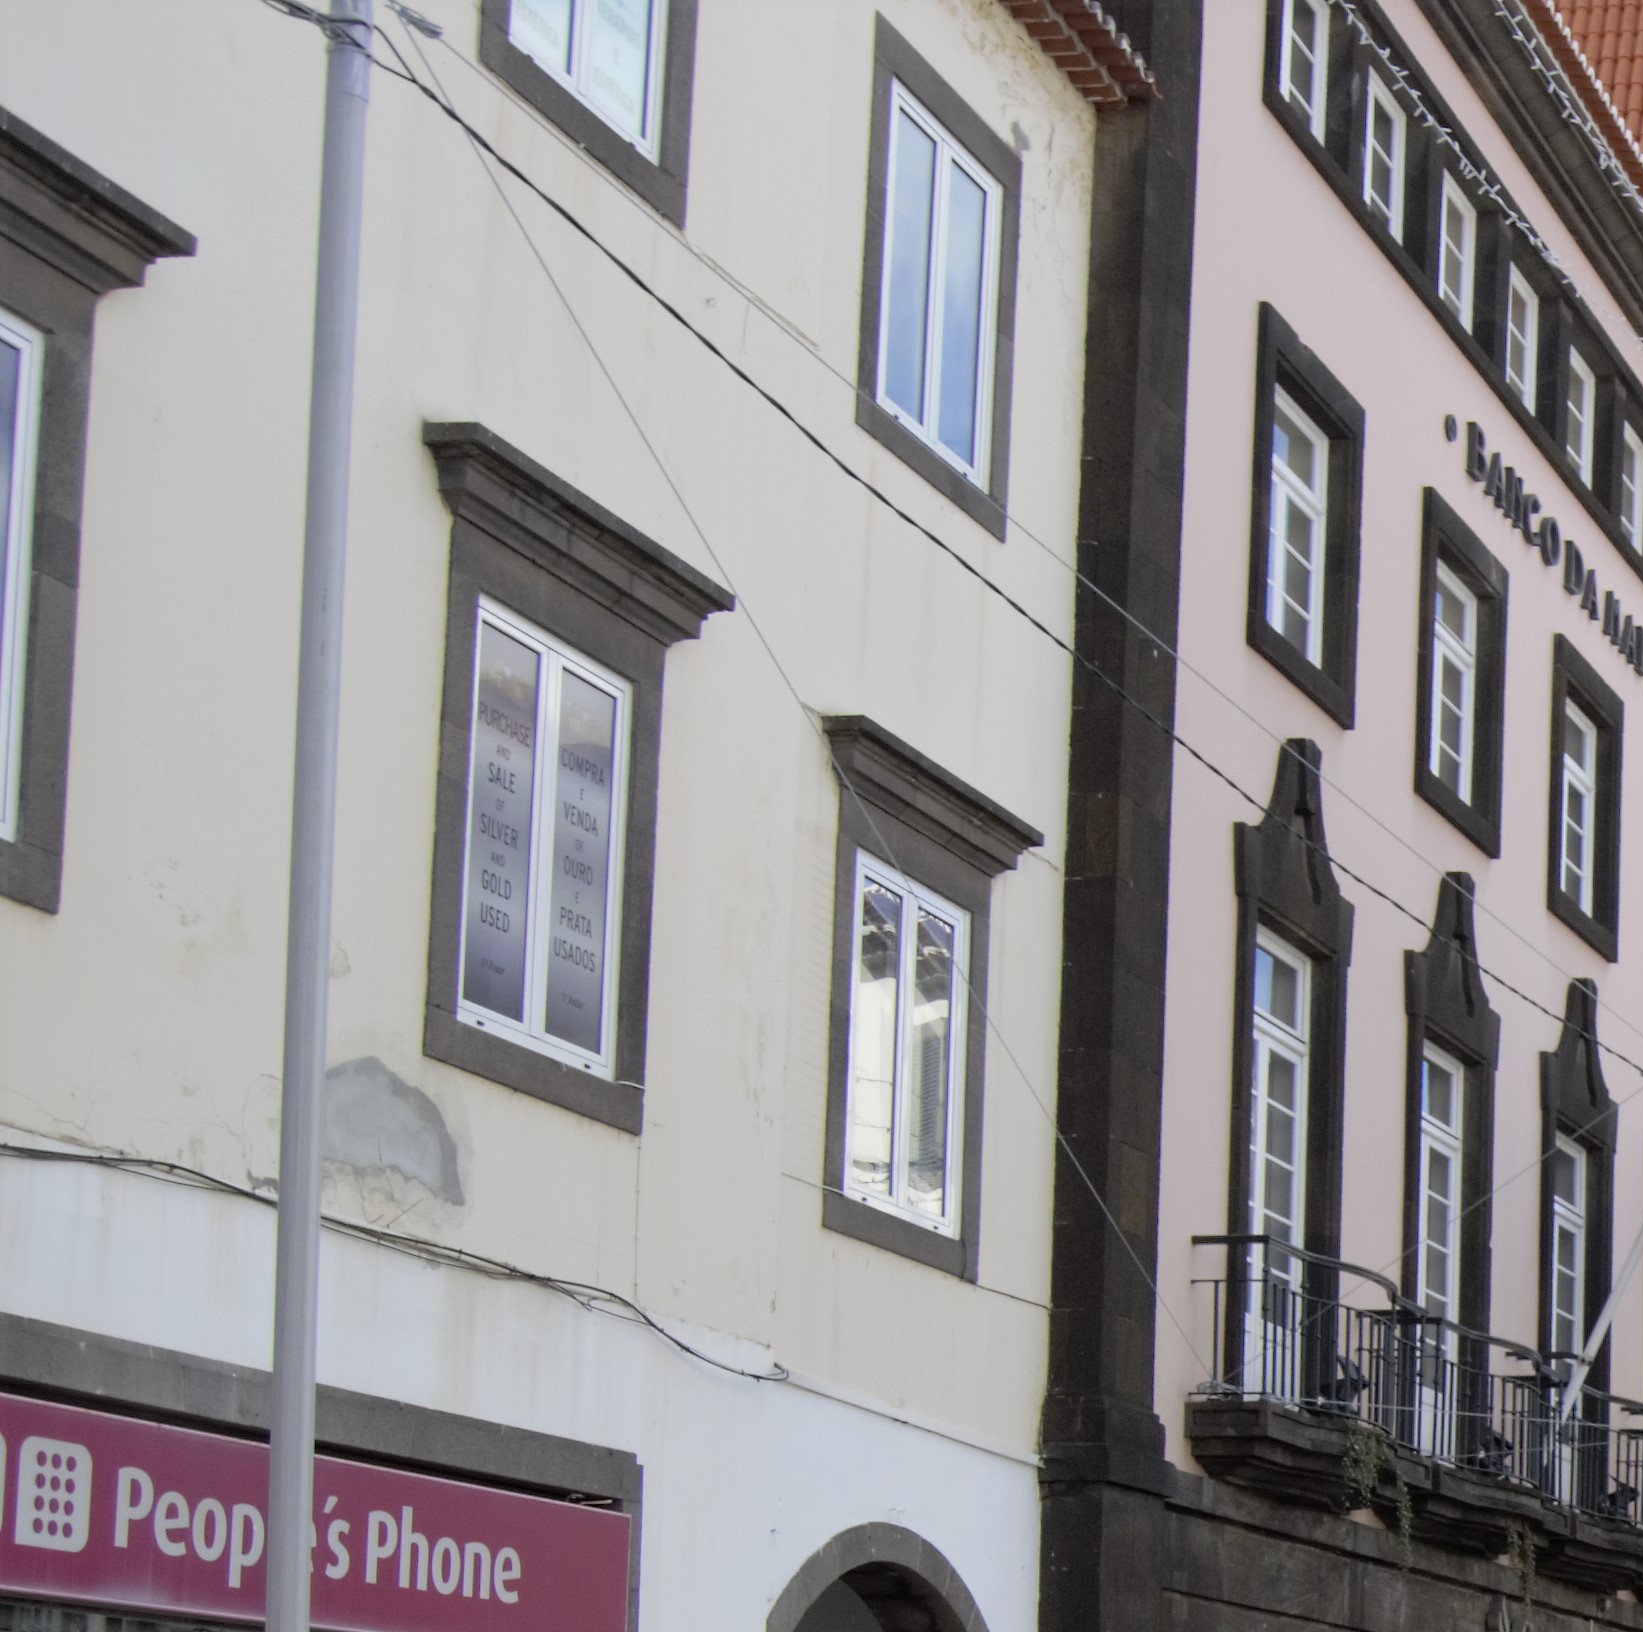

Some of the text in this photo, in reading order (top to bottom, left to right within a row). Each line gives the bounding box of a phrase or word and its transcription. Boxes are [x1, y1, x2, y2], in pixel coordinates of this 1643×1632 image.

[1466, 422, 1560, 566] BANCO
[1564, 540, 1599, 620] DA
[479, 701, 532, 748] PURCHASE
[488, 761, 516, 794] SALE
[561, 747, 606, 788] COMPRA
[480, 812, 519, 850] SILVER
[564, 801, 599, 837] VENDA
[481, 869, 512, 900] GOLD
[563, 855, 594, 886] OURO
[480, 902, 511, 933] USED
[560, 906, 593, 939] PRATA
[554, 936, 596, 973] USADOS
[114, 1466, 521, 1604] Peop's Phone
